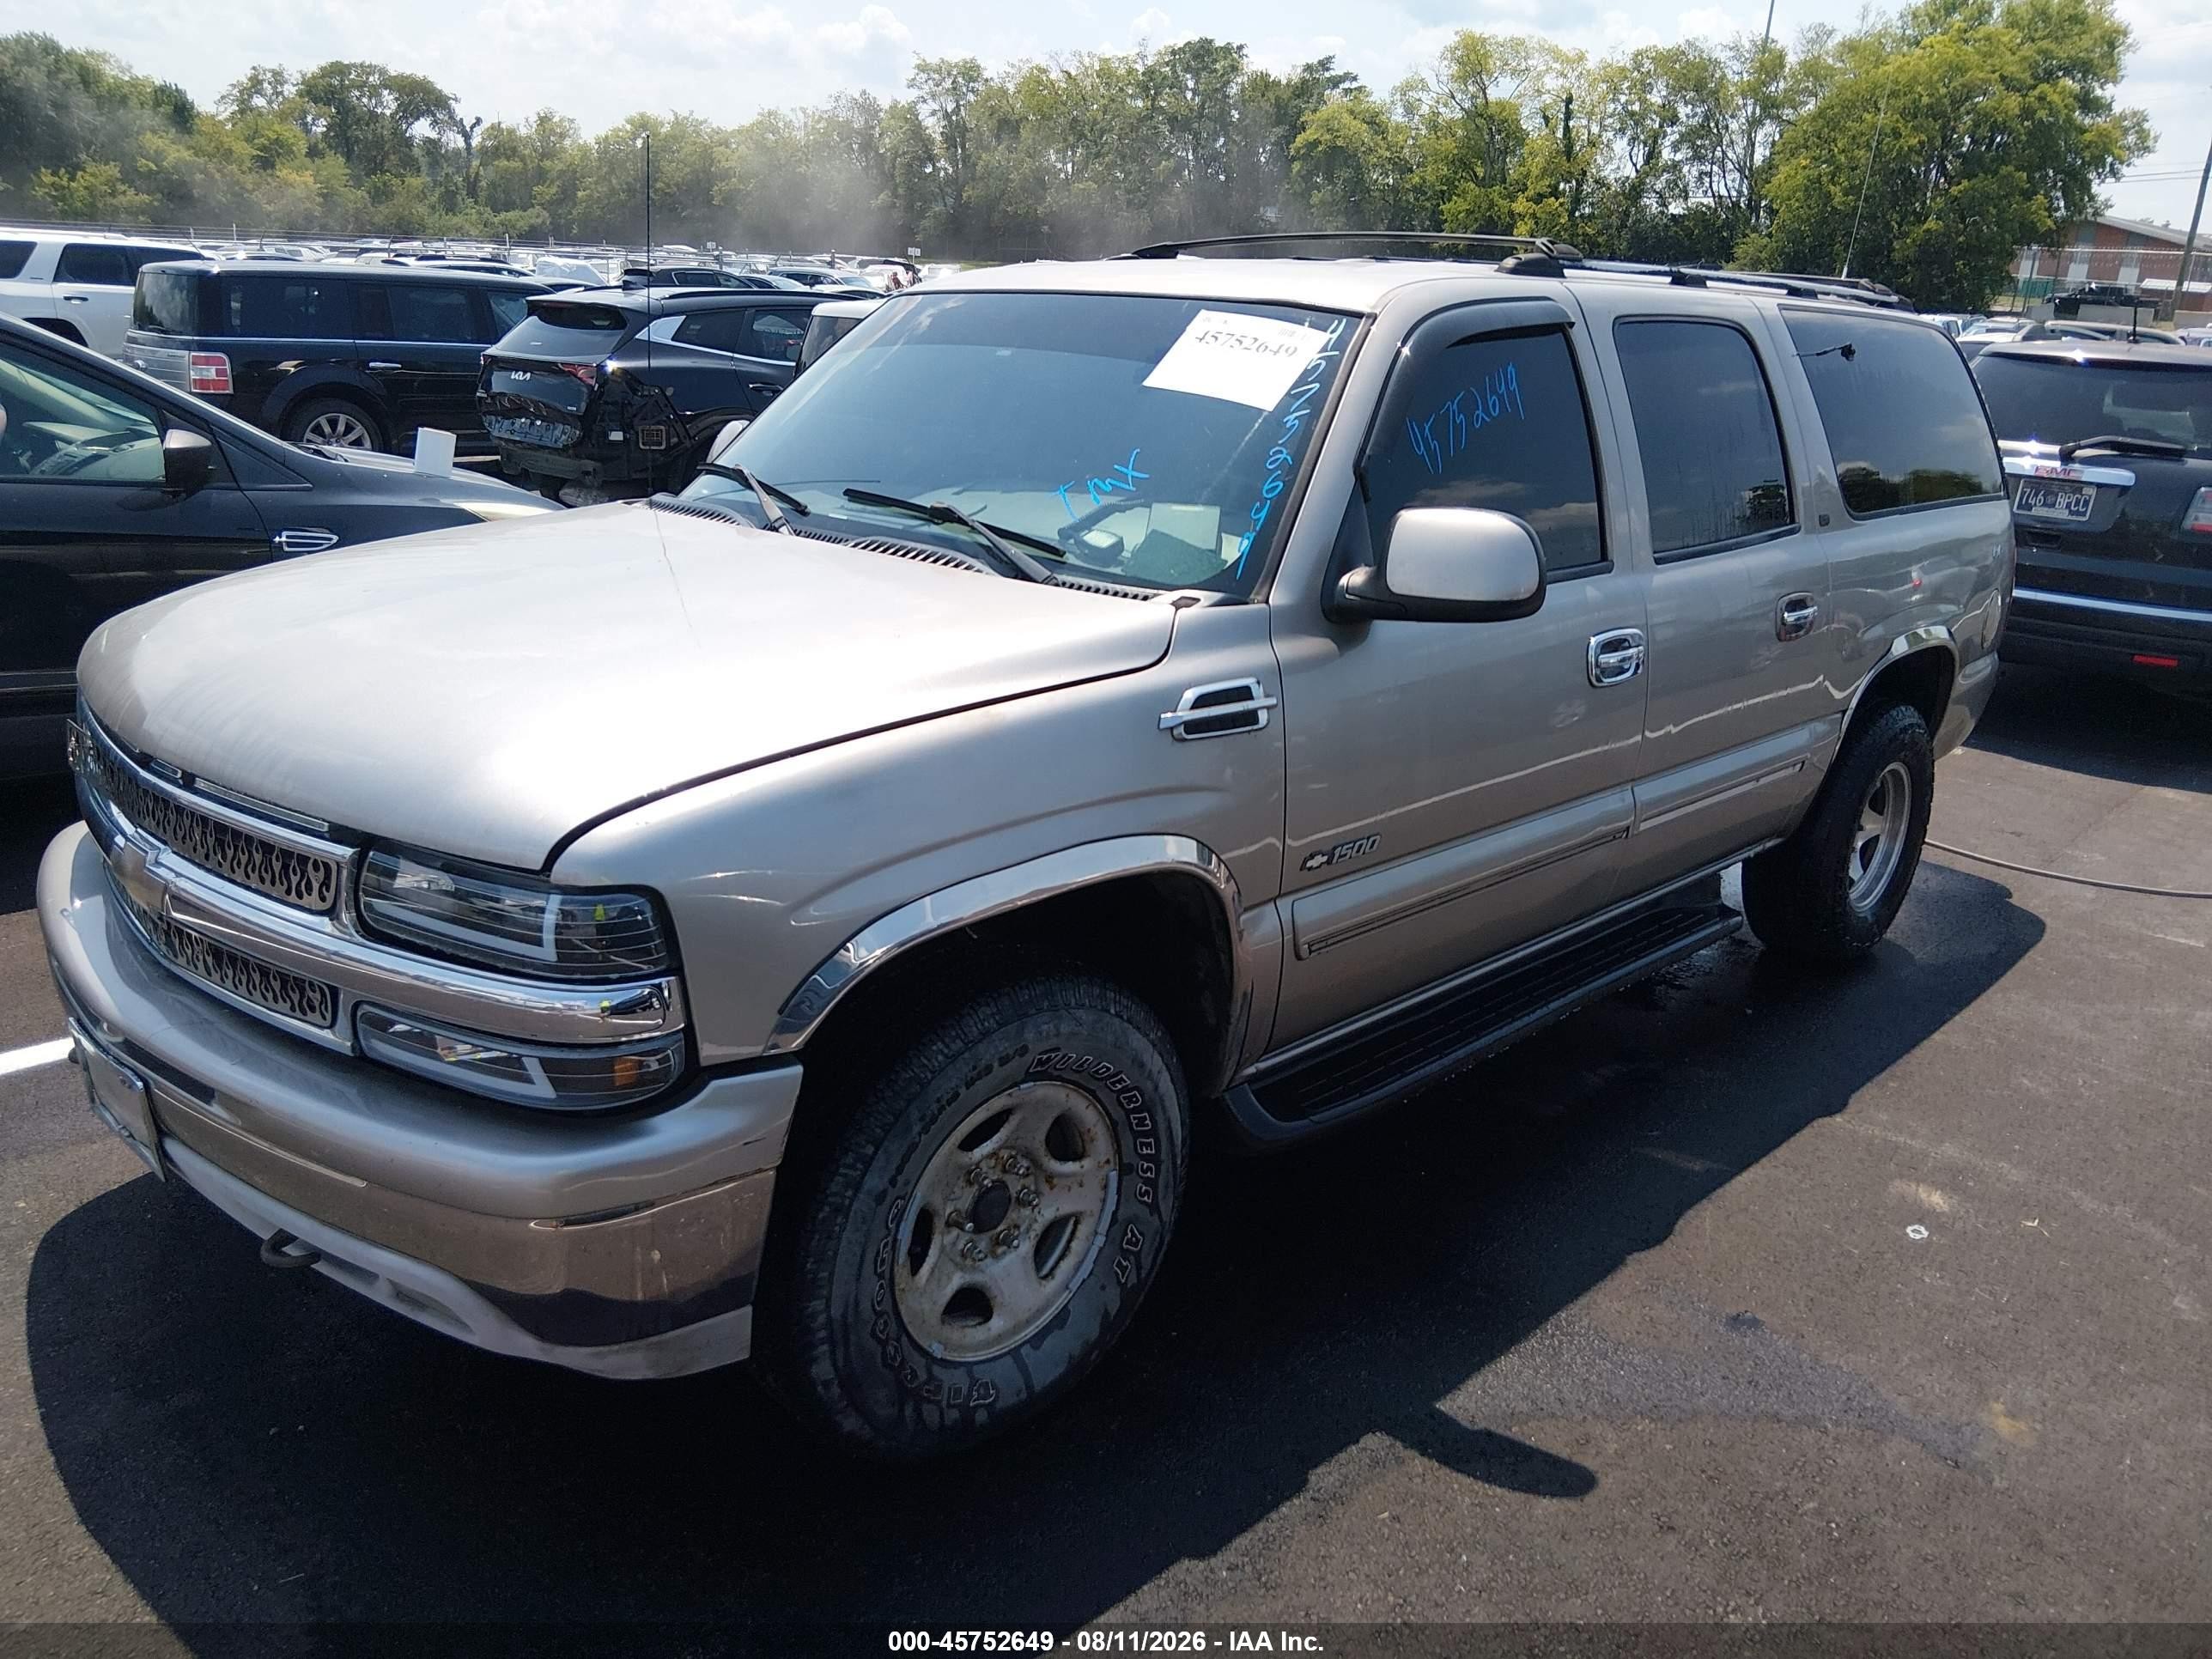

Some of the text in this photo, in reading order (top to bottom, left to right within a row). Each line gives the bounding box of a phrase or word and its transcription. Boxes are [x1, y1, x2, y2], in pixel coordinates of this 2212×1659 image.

[1194, 330, 1299, 358] 45752649
[510, 370, 532, 380] KIA
[1406, 361, 1525, 475] 45752649
[1236, 318, 1347, 581] 45752649
[2033, 465, 2085, 480] GMC
[2021, 488, 2045, 507] 746
[2055, 492, 2090, 513] BPCC
[1331, 834, 1382, 865] 1500
[1028, 1049, 1156, 1285] WILDERNESS AT
